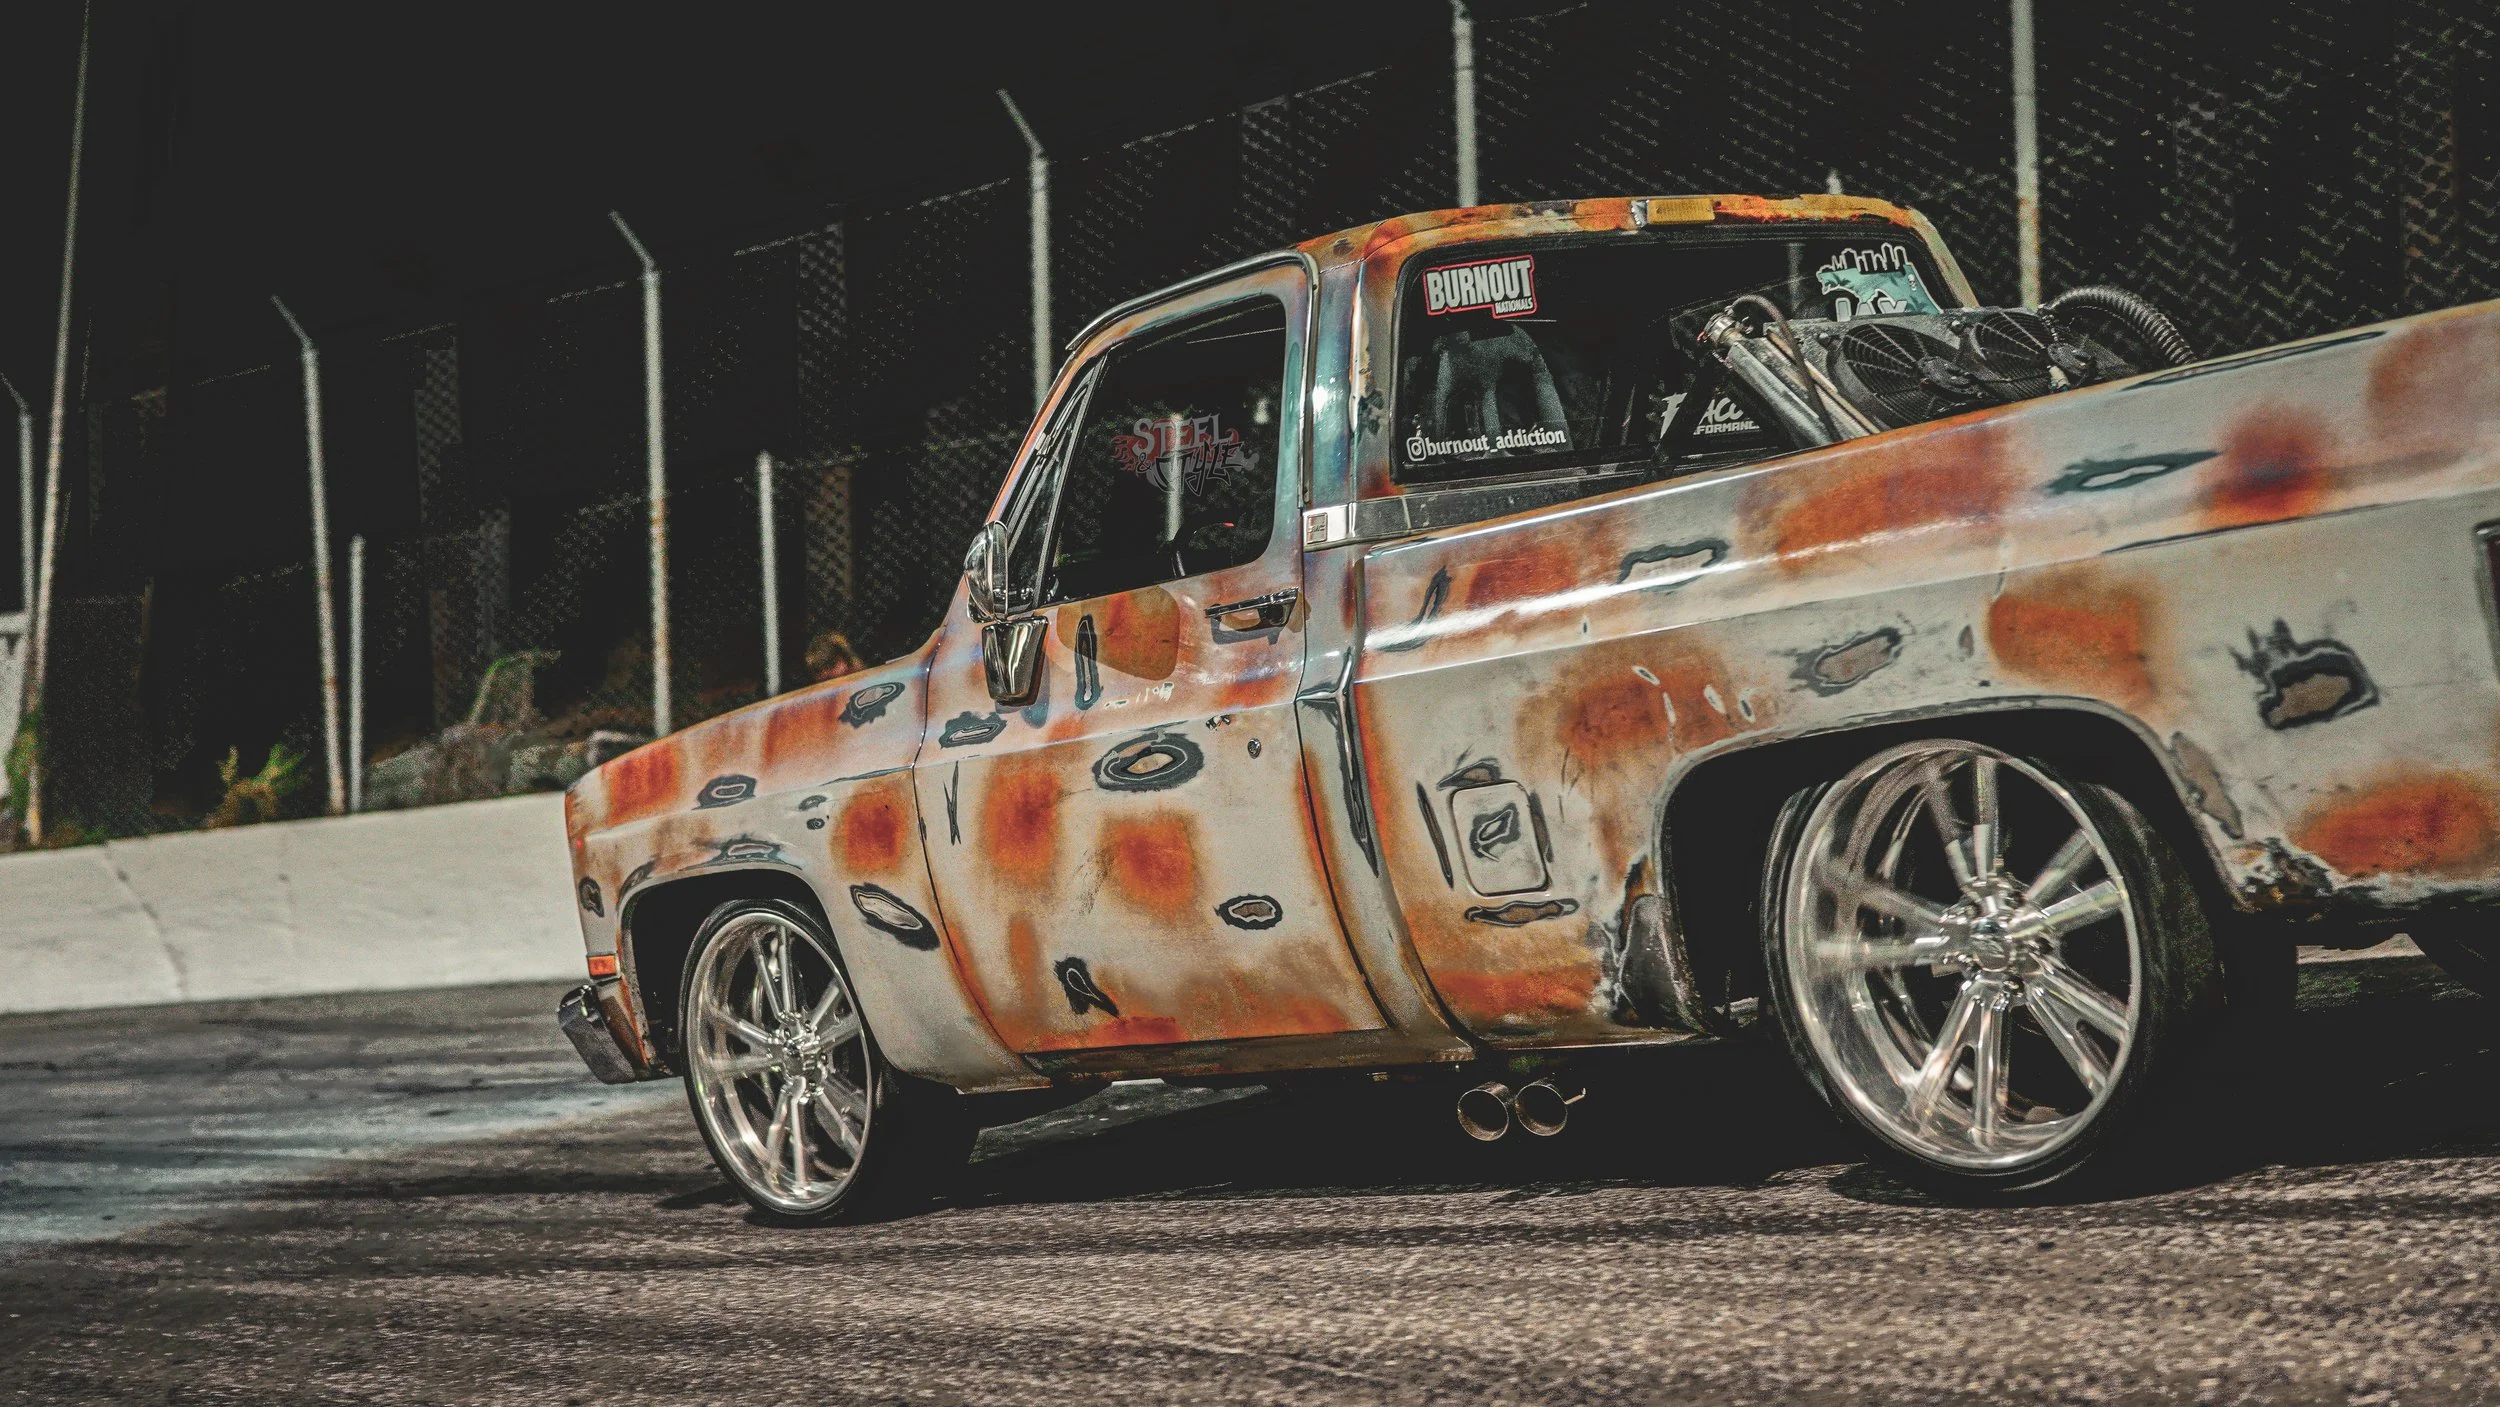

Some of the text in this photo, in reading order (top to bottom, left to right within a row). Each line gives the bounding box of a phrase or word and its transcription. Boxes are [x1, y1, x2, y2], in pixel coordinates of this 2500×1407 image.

[1426, 259, 1532, 311] BURNOUT
[1494, 297, 1534, 314] NATIONALS
[1132, 412, 1237, 457] STEEL
[1425, 427, 1567, 456] burnout_addiction
